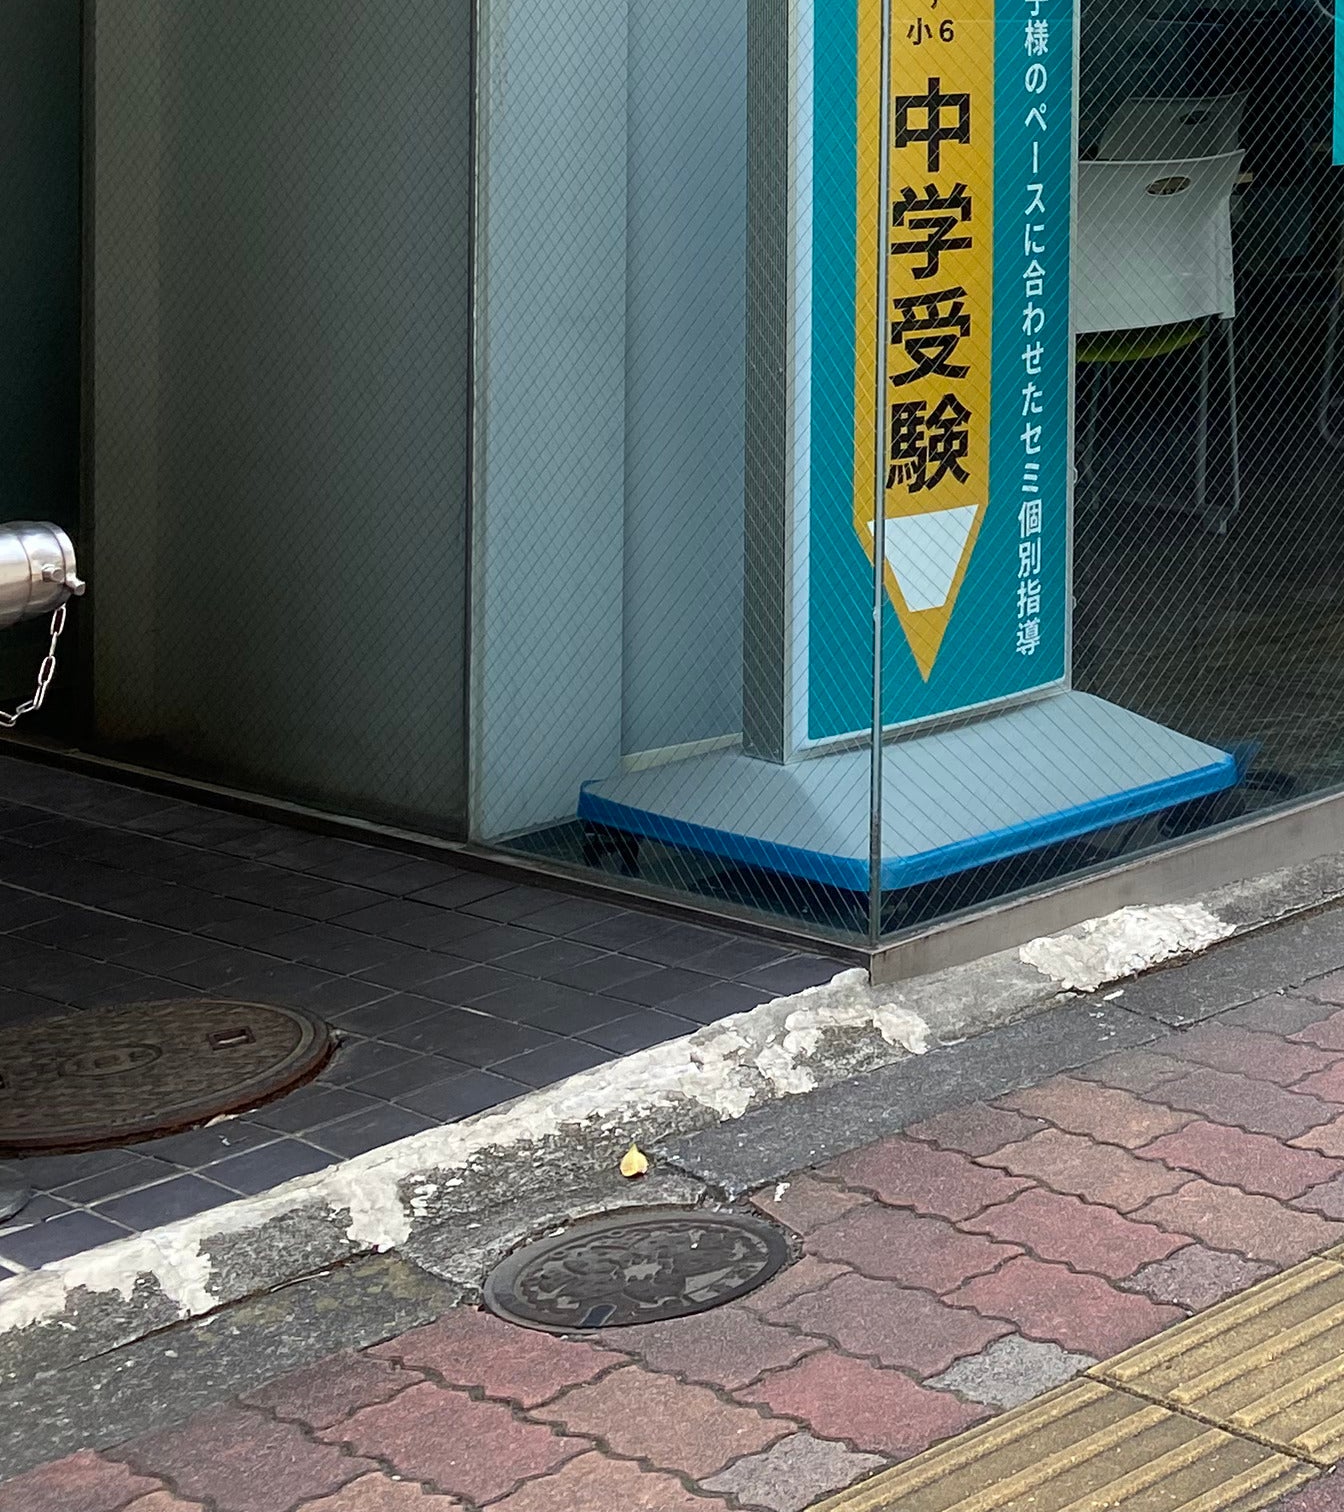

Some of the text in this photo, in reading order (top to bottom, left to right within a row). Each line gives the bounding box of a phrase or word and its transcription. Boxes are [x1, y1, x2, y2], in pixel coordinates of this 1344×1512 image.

[906, 17, 955, 46] 小6
[885, 76, 973, 494] 中学受験
